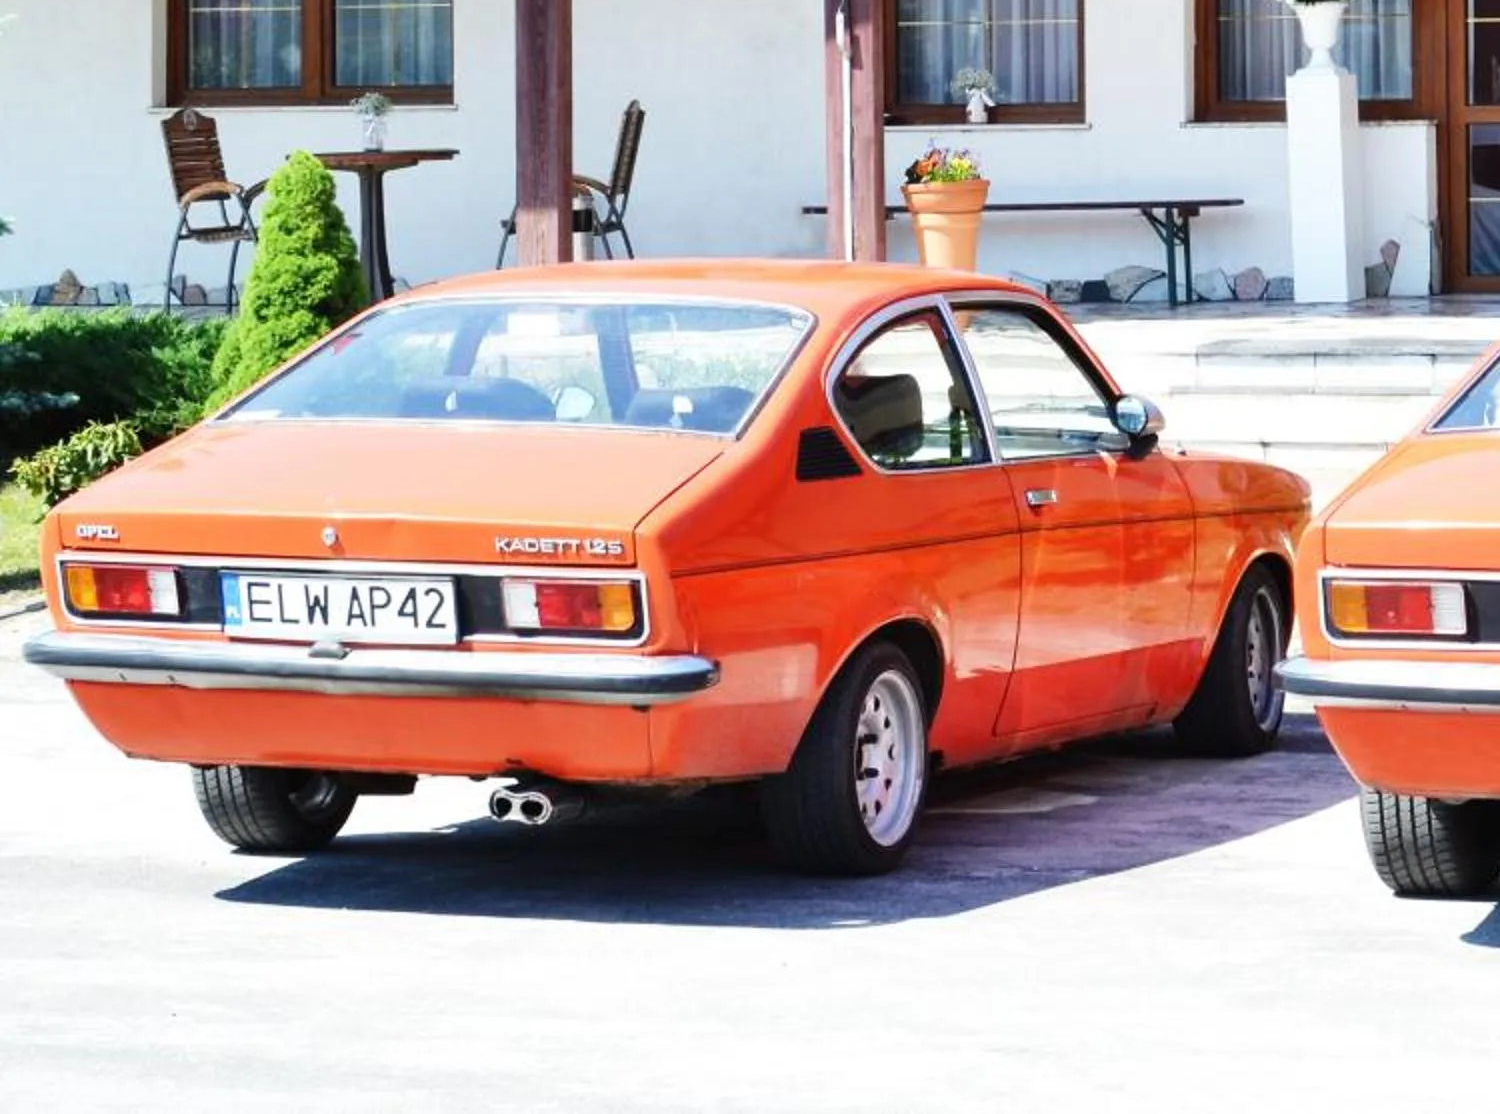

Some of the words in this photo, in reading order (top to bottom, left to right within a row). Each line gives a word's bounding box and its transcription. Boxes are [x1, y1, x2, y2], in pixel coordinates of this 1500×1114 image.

[76, 525, 118, 538] OPEL
[495, 536, 580, 554] KADETT
[247, 581, 328, 625] ELW
[346, 585, 446, 628] AP42
